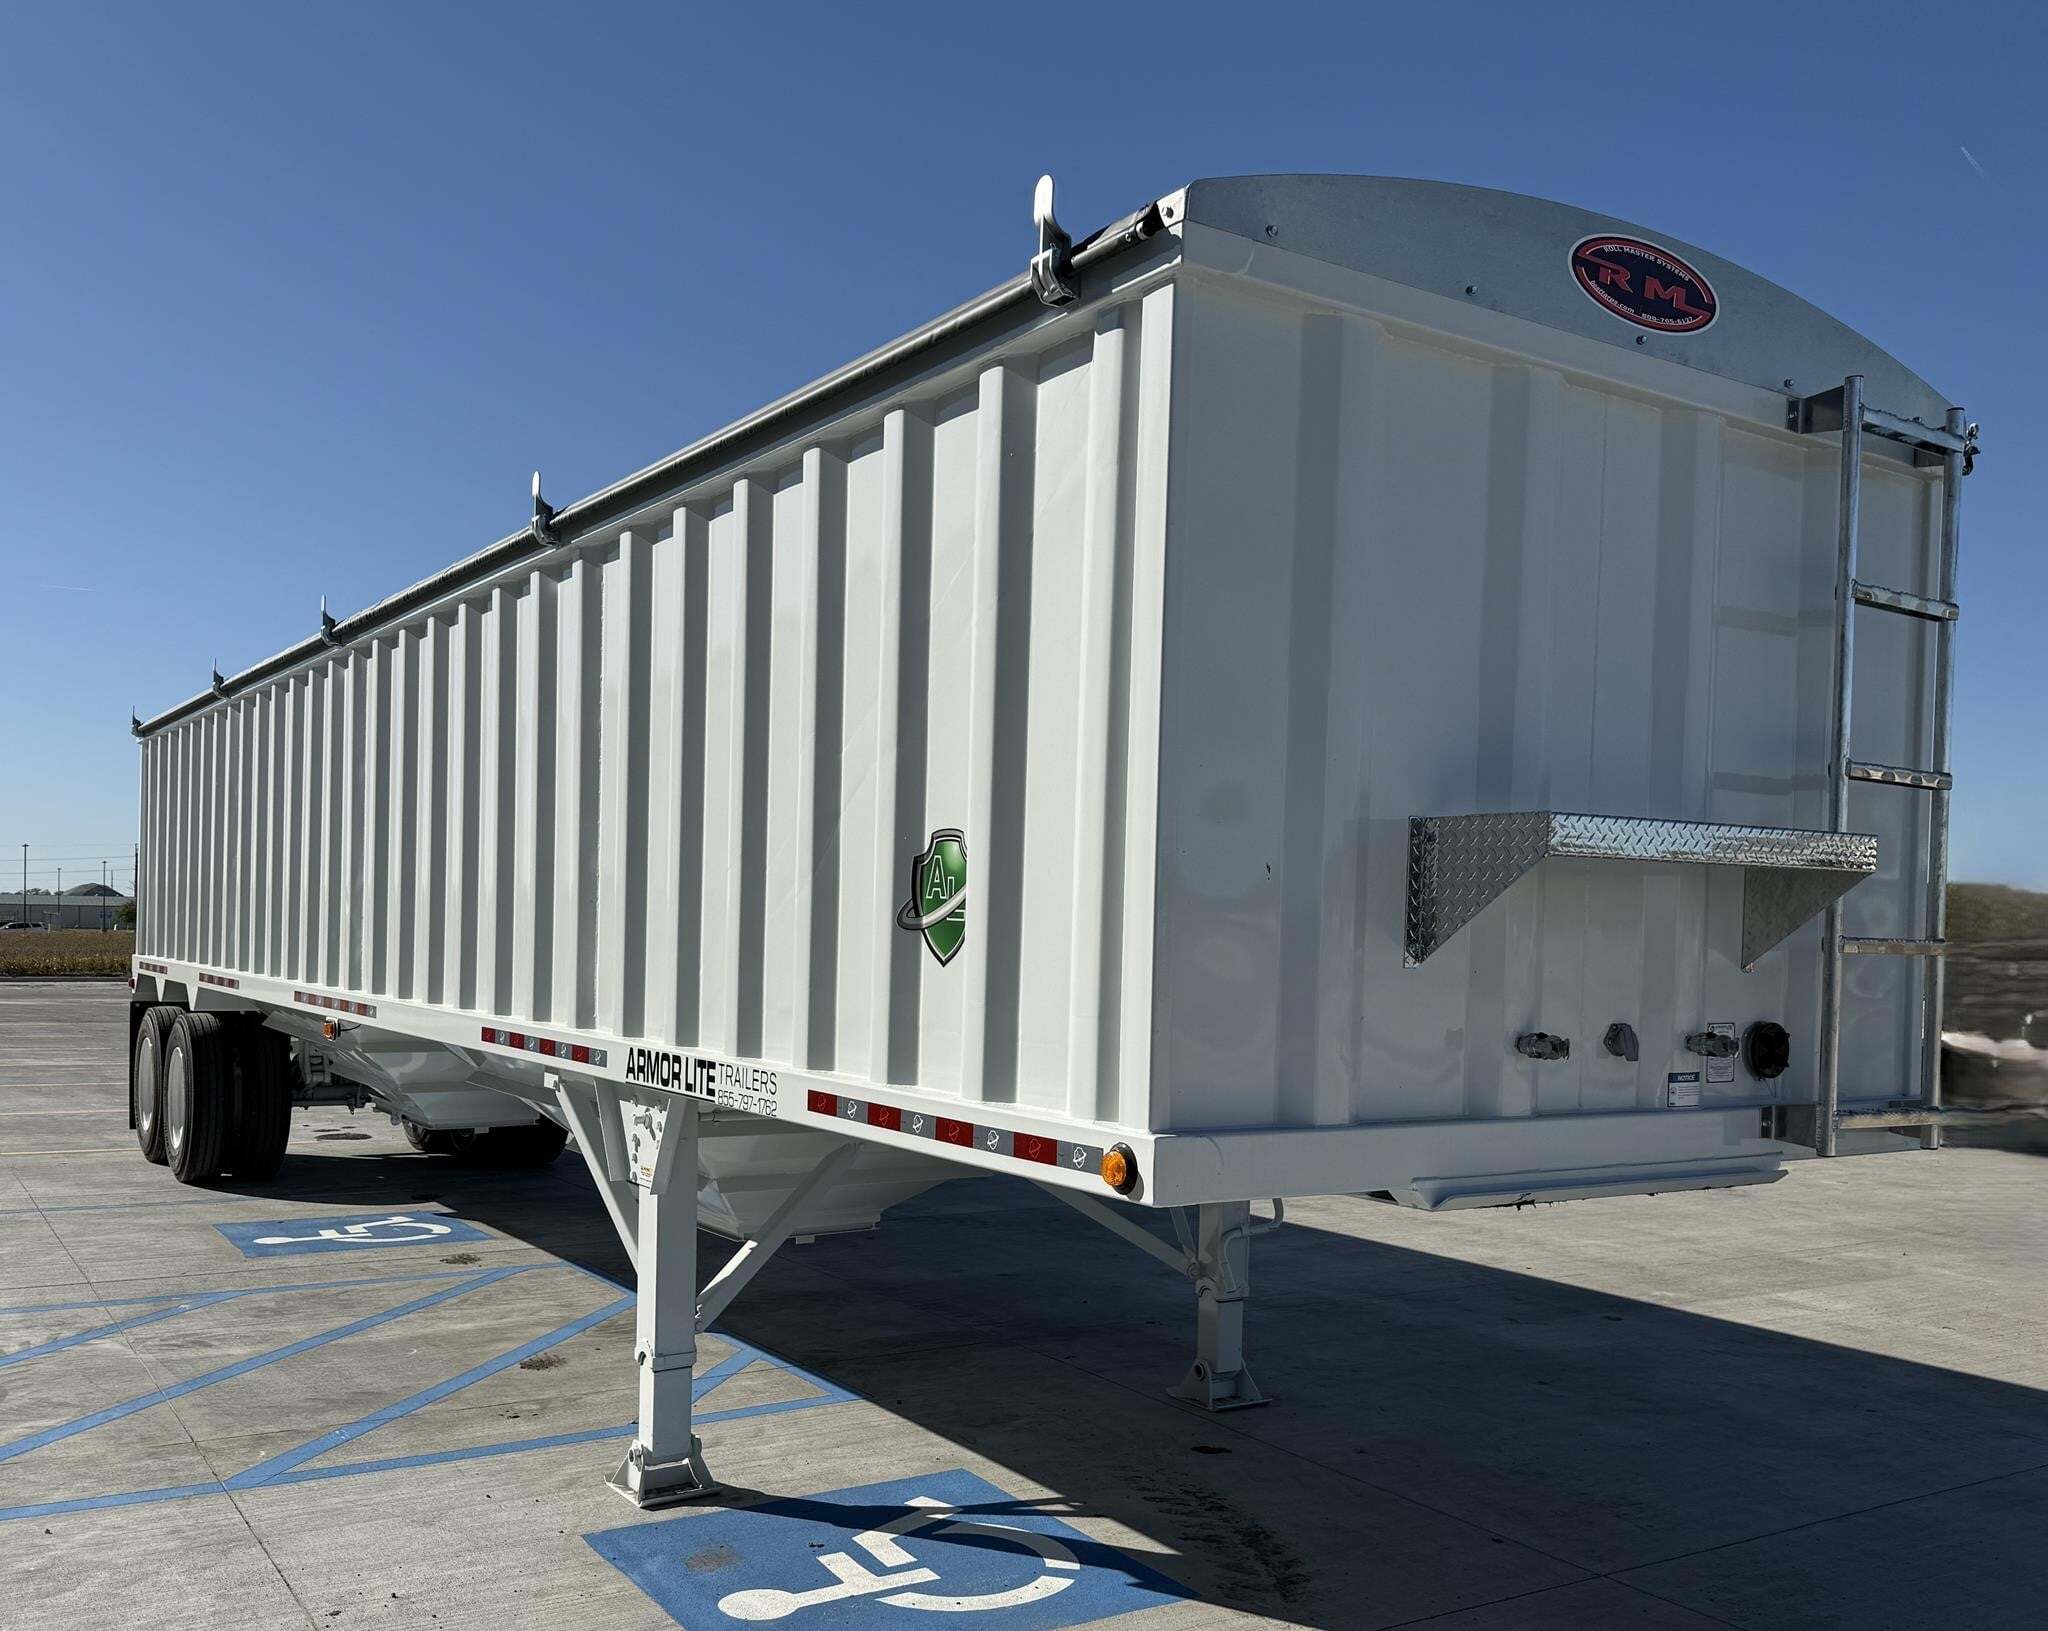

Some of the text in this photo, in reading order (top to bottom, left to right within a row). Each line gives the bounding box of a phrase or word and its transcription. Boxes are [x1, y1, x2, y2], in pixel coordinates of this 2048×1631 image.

[1604, 244, 1690, 282] ROLL MASTER SYSTEMS
[625, 1047, 778, 1098] ARMOR LITE TRAILERS
[717, 1089, 778, 1117] 855-797-1762
